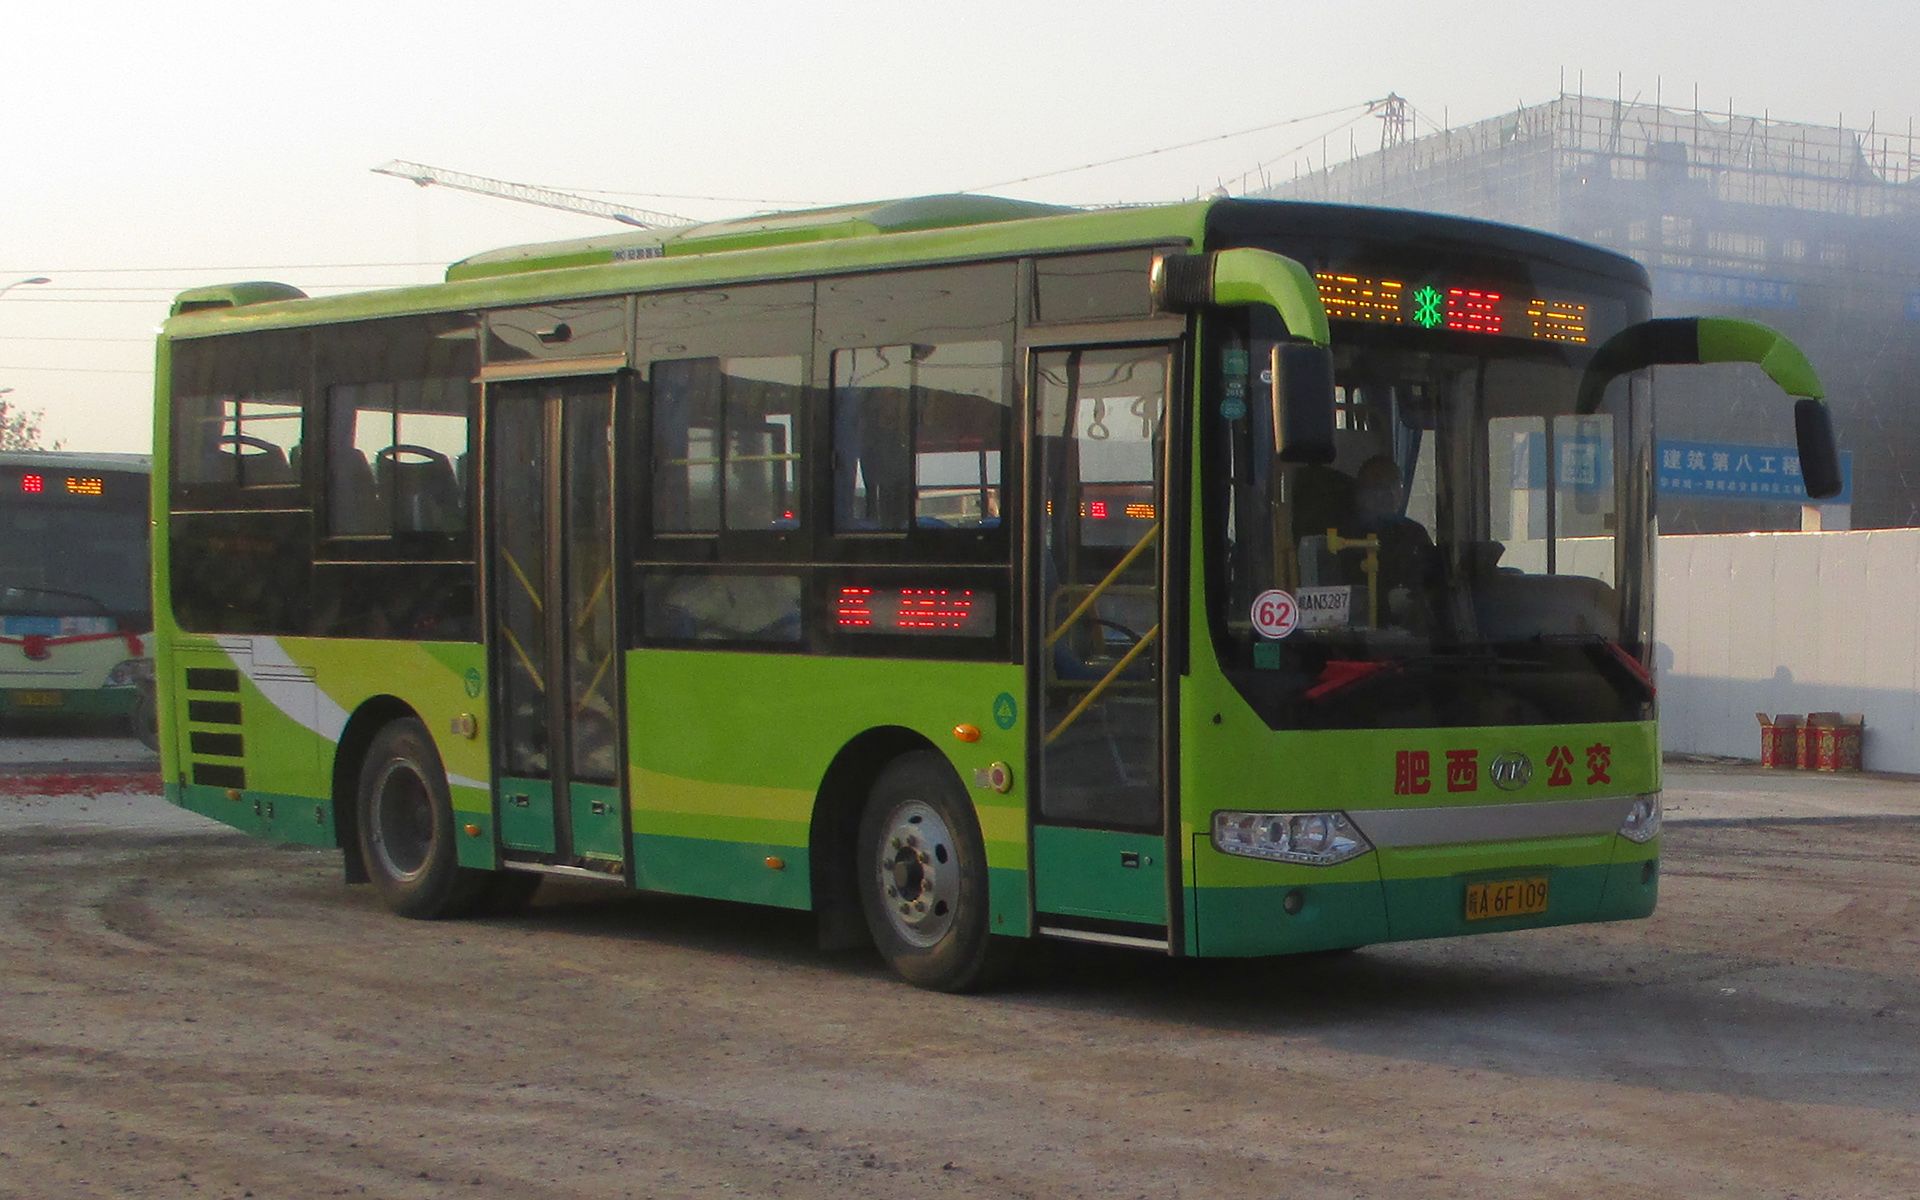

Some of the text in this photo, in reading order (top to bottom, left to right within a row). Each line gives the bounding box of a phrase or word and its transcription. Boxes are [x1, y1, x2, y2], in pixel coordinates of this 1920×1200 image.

[1663, 448, 1801, 476] 建筑第八工程
[1259, 601, 1290, 628] 62
[1394, 742, 1612, 795] 肥西 公交
